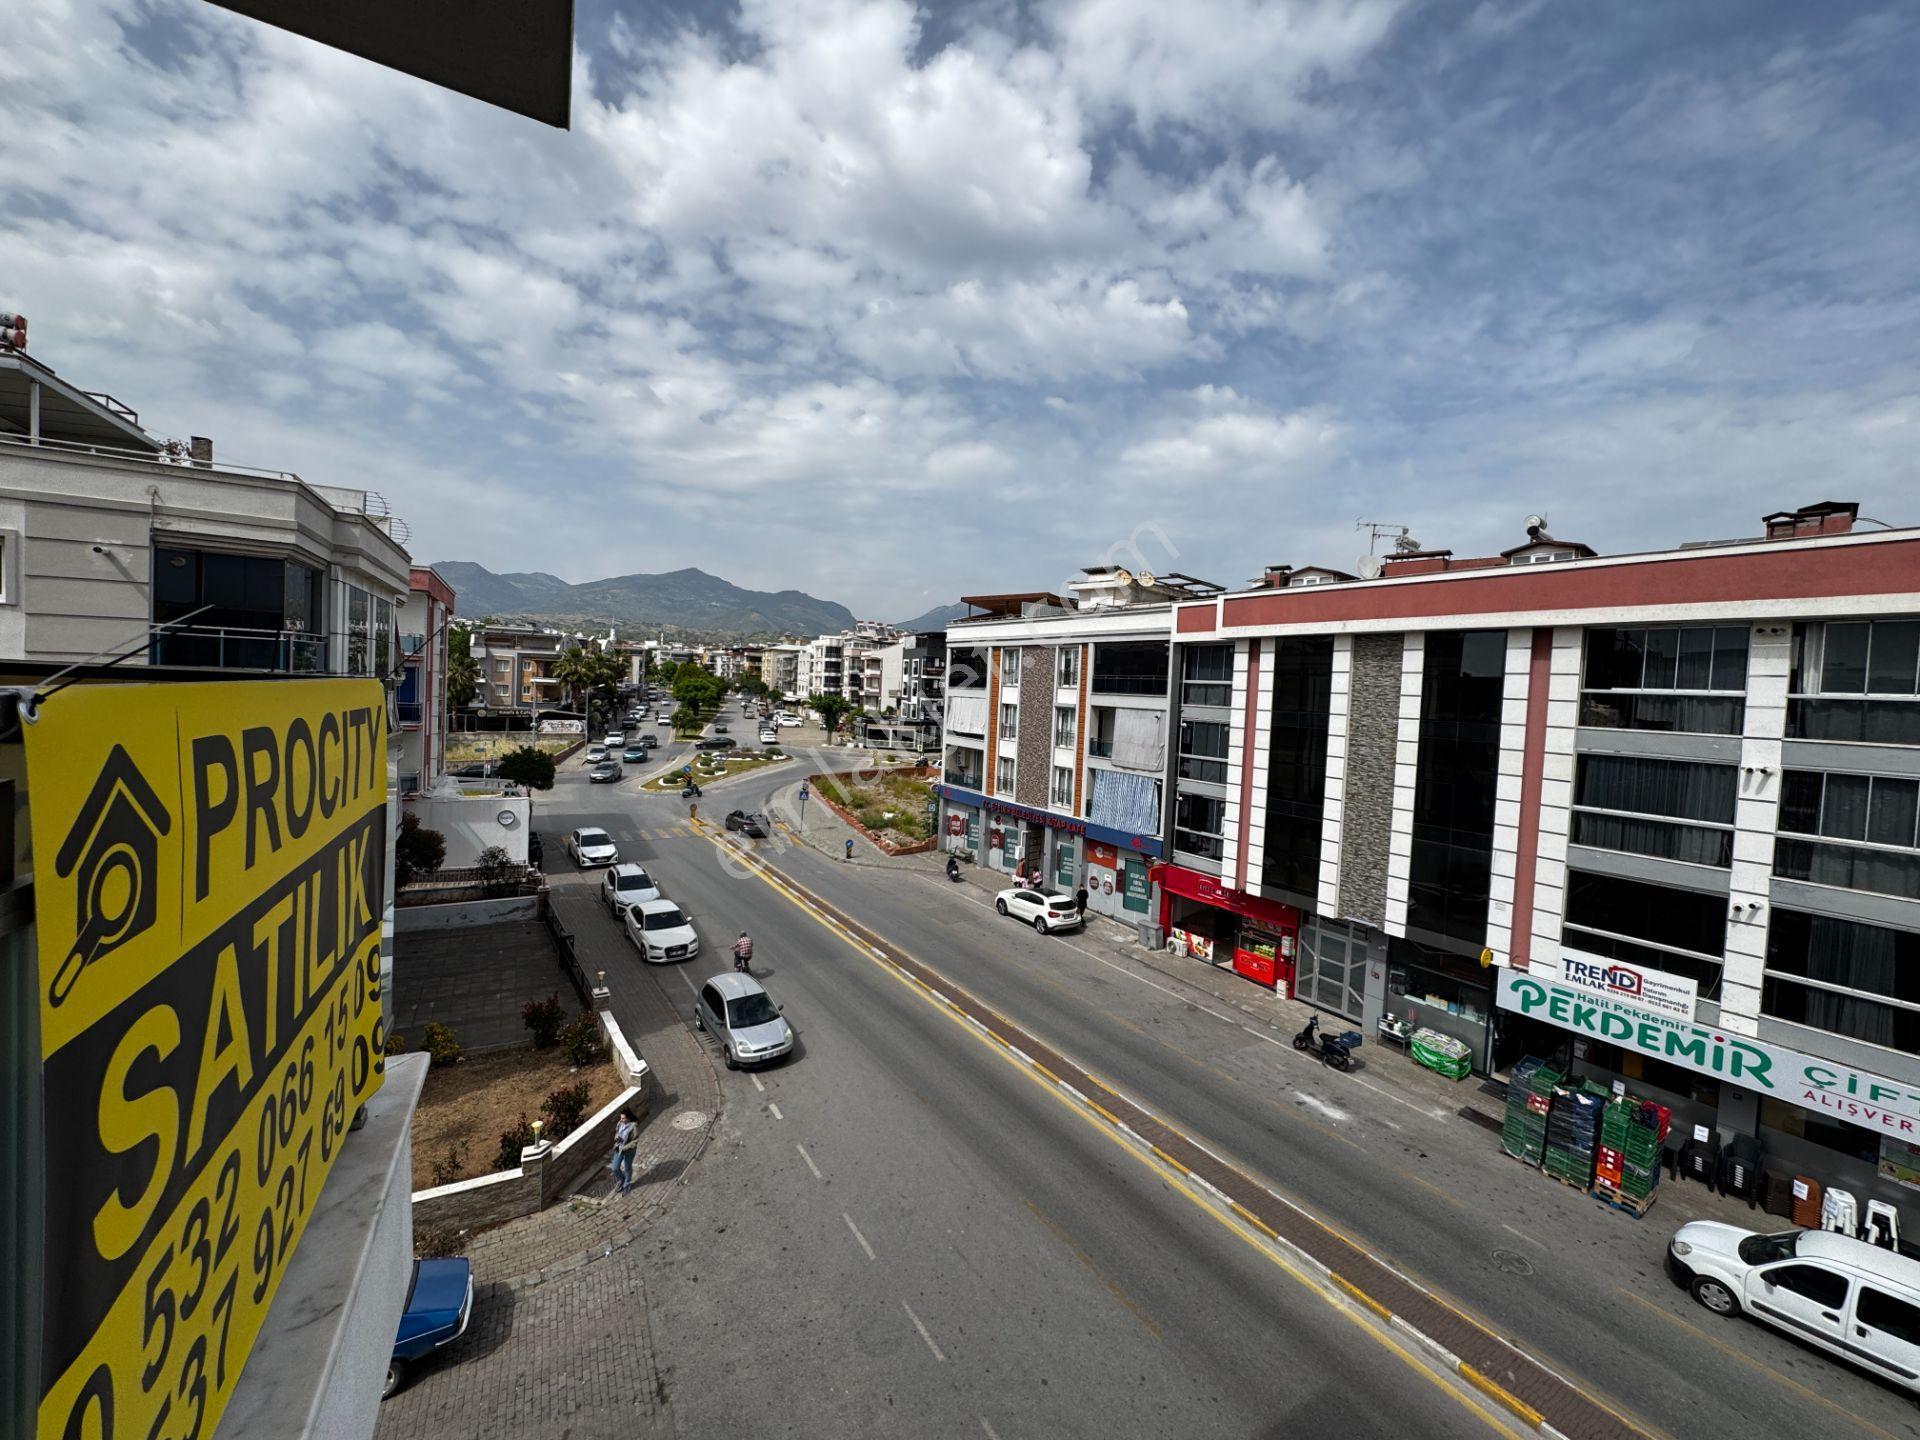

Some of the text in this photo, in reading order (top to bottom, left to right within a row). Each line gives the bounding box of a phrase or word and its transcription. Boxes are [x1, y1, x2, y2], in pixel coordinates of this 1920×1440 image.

[192, 705, 382, 904] PROCITY
[1562, 958, 1636, 988] TREND
[1565, 973, 1606, 991] EMLAK
[1577, 993, 1689, 1032] Halil Pekdemir
[1643, 978, 1690, 995] Gayrimenkul
[93, 824, 374, 1260] SATILIK
[1509, 979, 1774, 1089] PEKDEMİR
[141, 943, 382, 1393] 532 066 15 09
[150, 1016, 385, 1440] 37 927 69 09
